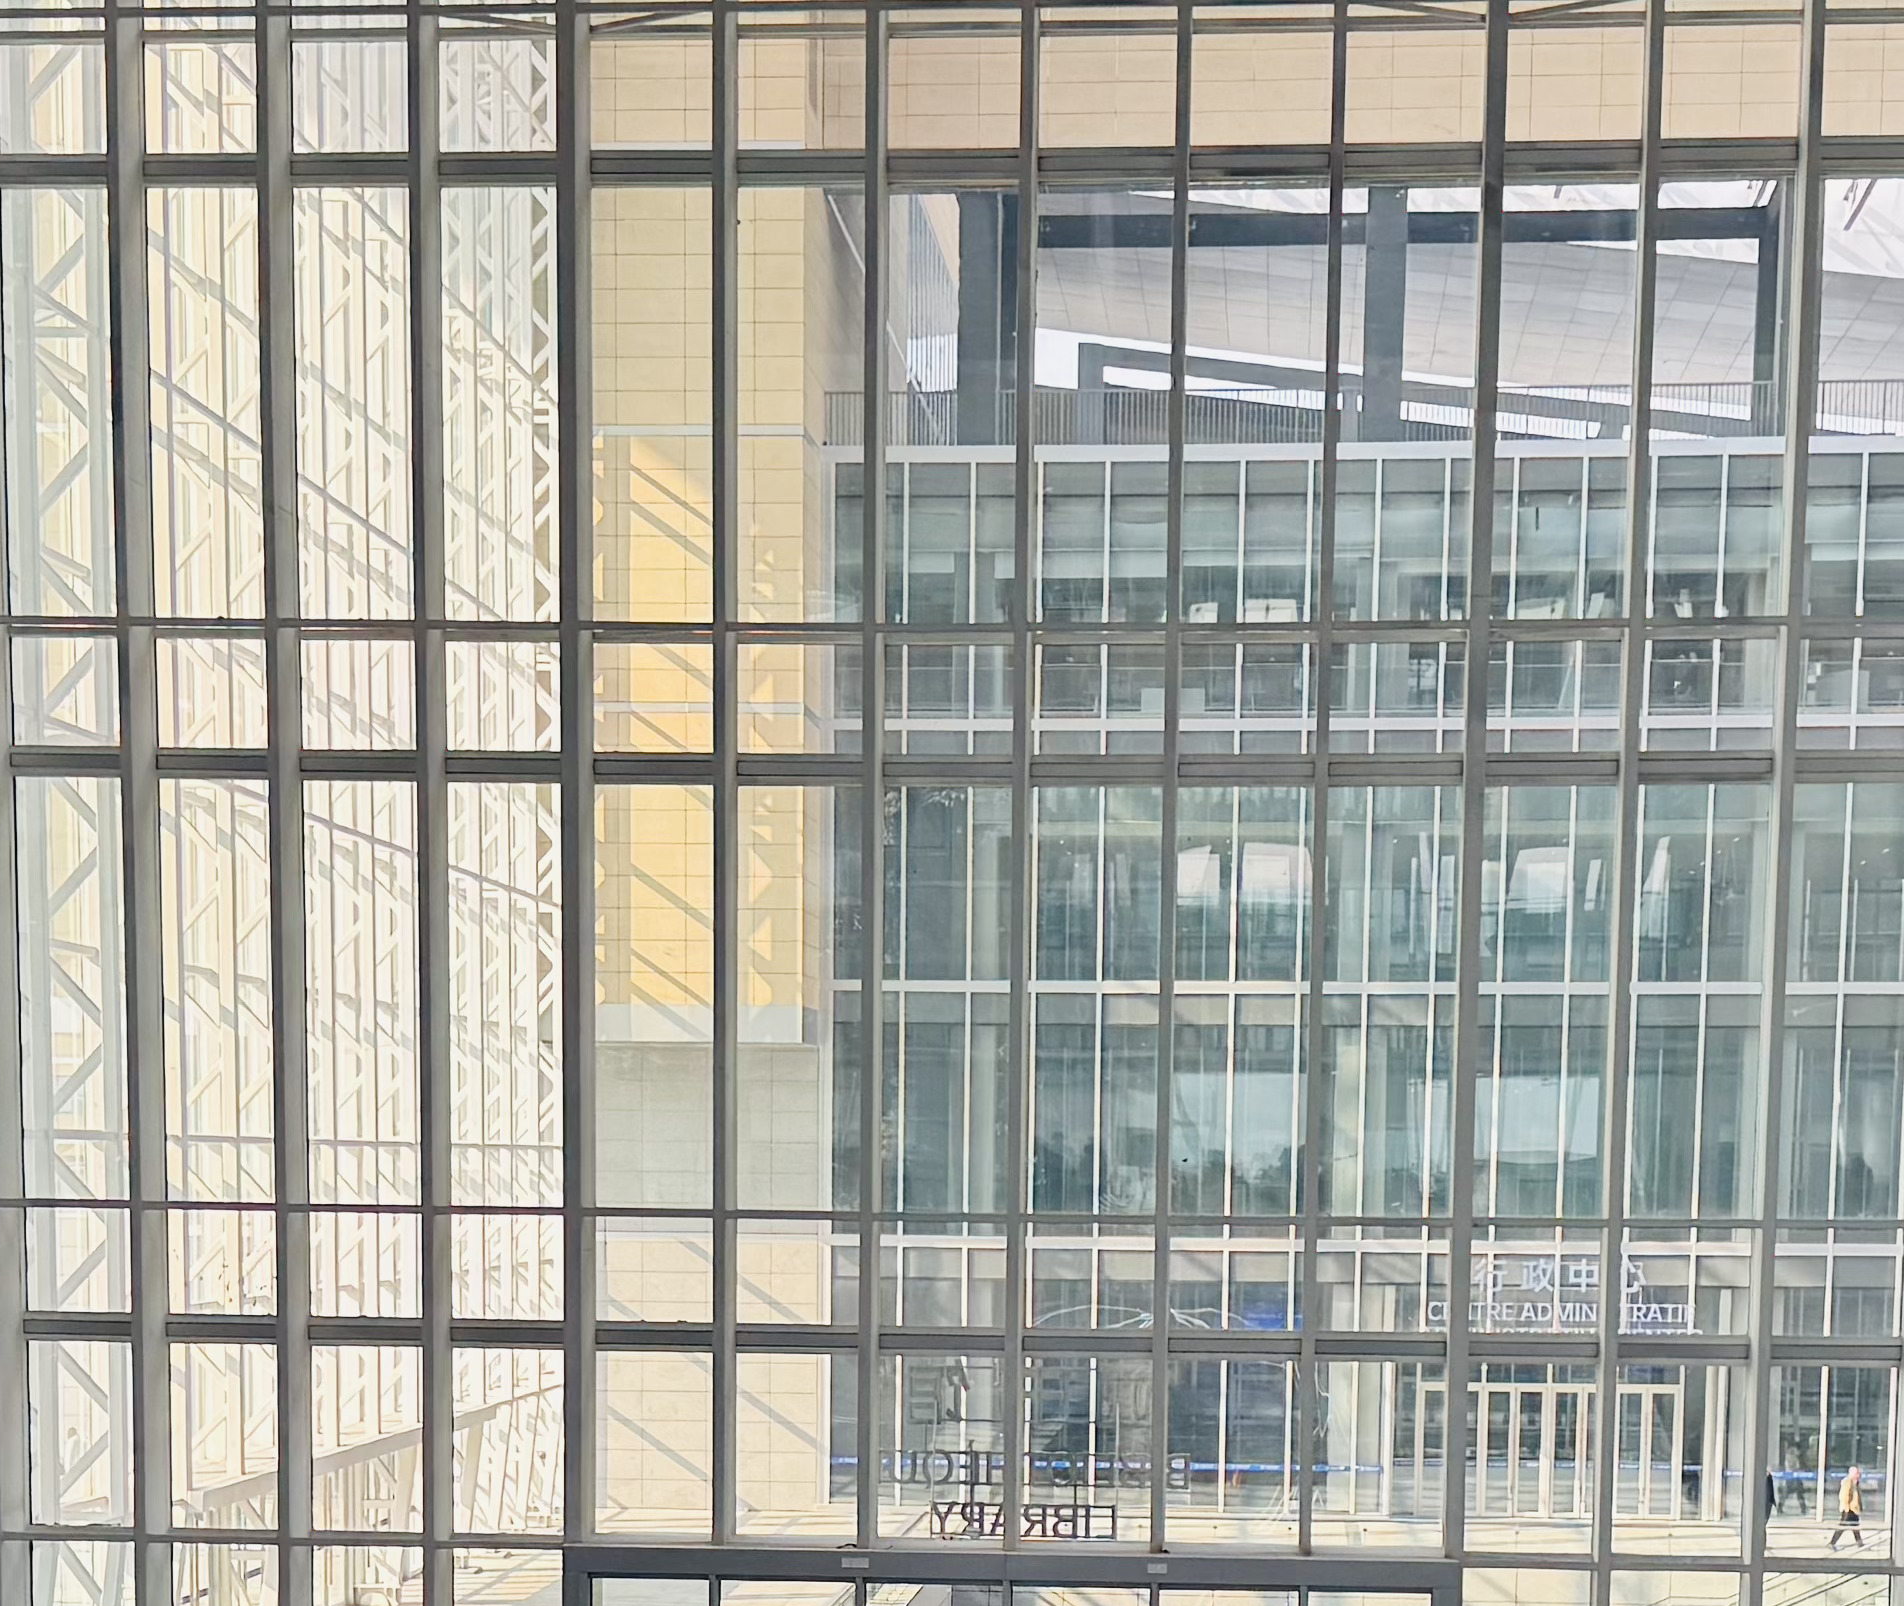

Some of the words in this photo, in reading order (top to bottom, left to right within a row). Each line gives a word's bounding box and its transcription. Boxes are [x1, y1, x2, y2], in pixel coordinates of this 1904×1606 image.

[1474, 1256, 1646, 1294] 行政中心
[1428, 1301, 1514, 1321] CTRE
